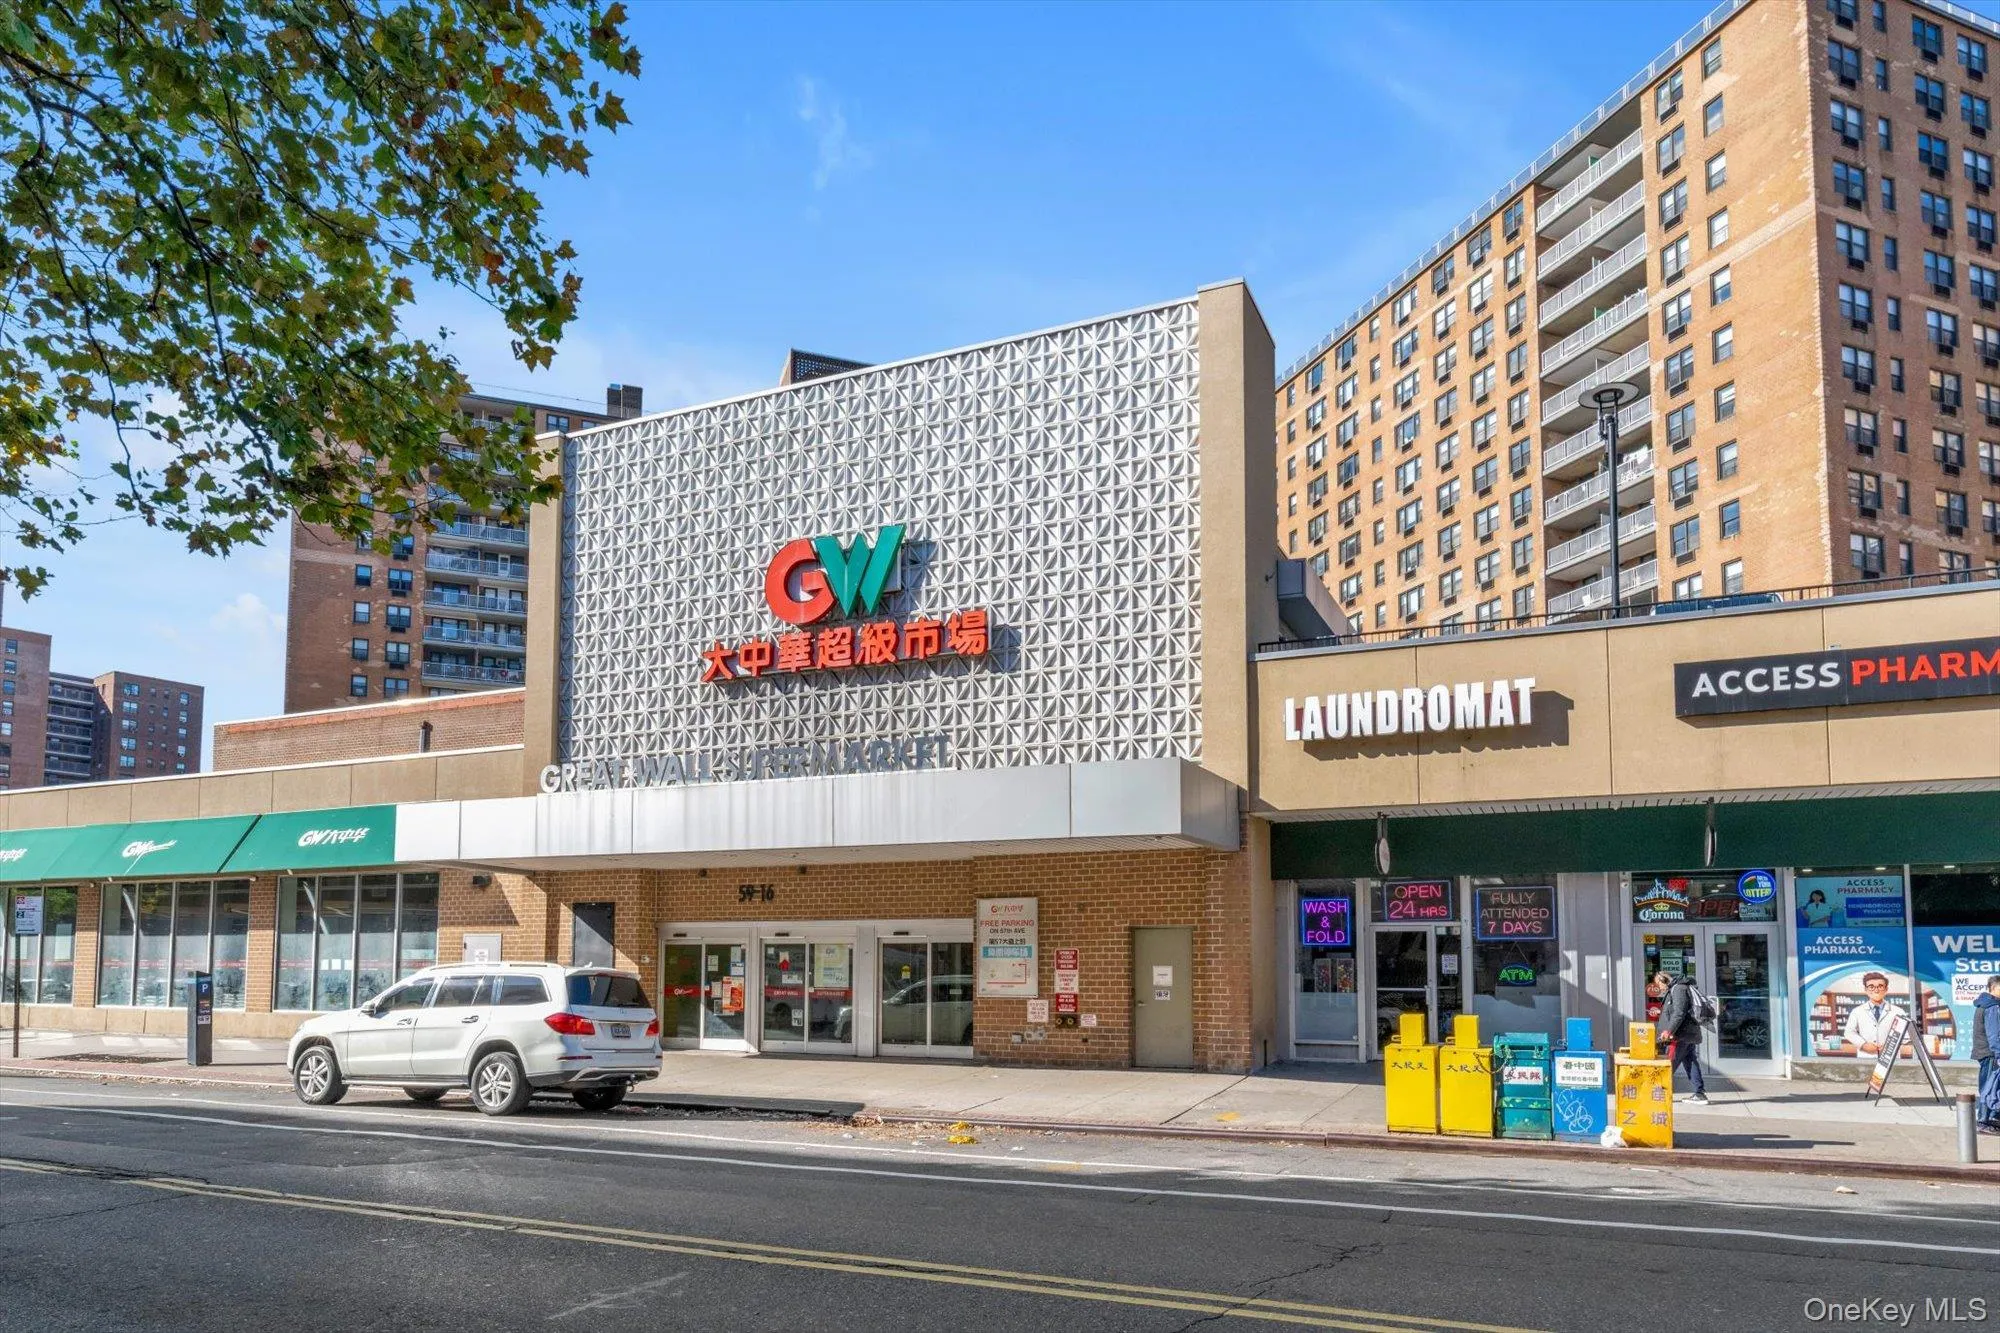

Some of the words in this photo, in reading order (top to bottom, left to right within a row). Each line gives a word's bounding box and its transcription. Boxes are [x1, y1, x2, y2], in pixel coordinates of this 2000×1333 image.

[765, 524, 905, 625] GW
[701, 609, 990, 683] 大中華超級市場
[1691, 661, 1841, 698] ACCESS
[1851, 648, 2000, 686] PHARM
[1284, 677, 1536, 741] LAUNDROMAT
[540, 760, 627, 794] GREAT
[633, 755, 712, 787] WALL
[721, 734, 952, 783] SUPERMARKET
[738, 884, 775, 903] 59-16
[1394, 884, 1442, 899] OPEN
[1837, 886, 1894, 894] PHARMACY
[1491, 892, 1535, 905] FULLY
[1304, 900, 1347, 914] WASH
[1389, 900, 1416, 919] 24
[1419, 906, 1447, 918] HRS
[1480, 907, 1549, 919] ATTENDED
[1320, 916, 1330, 928] &
[1639, 909, 1685, 922] Corona
[1488, 921, 1496, 934] 7
[1502, 920, 1542, 934] DAYS
[1306, 930, 1345, 943] FOLD
[1816, 936, 1863, 945] ACCESS
[1805, 946, 1875, 954] PHARMACY
[1932, 935, 2000, 953] WEL
[1498, 968, 1534, 981] ATM
[201, 983, 209, 993] P
